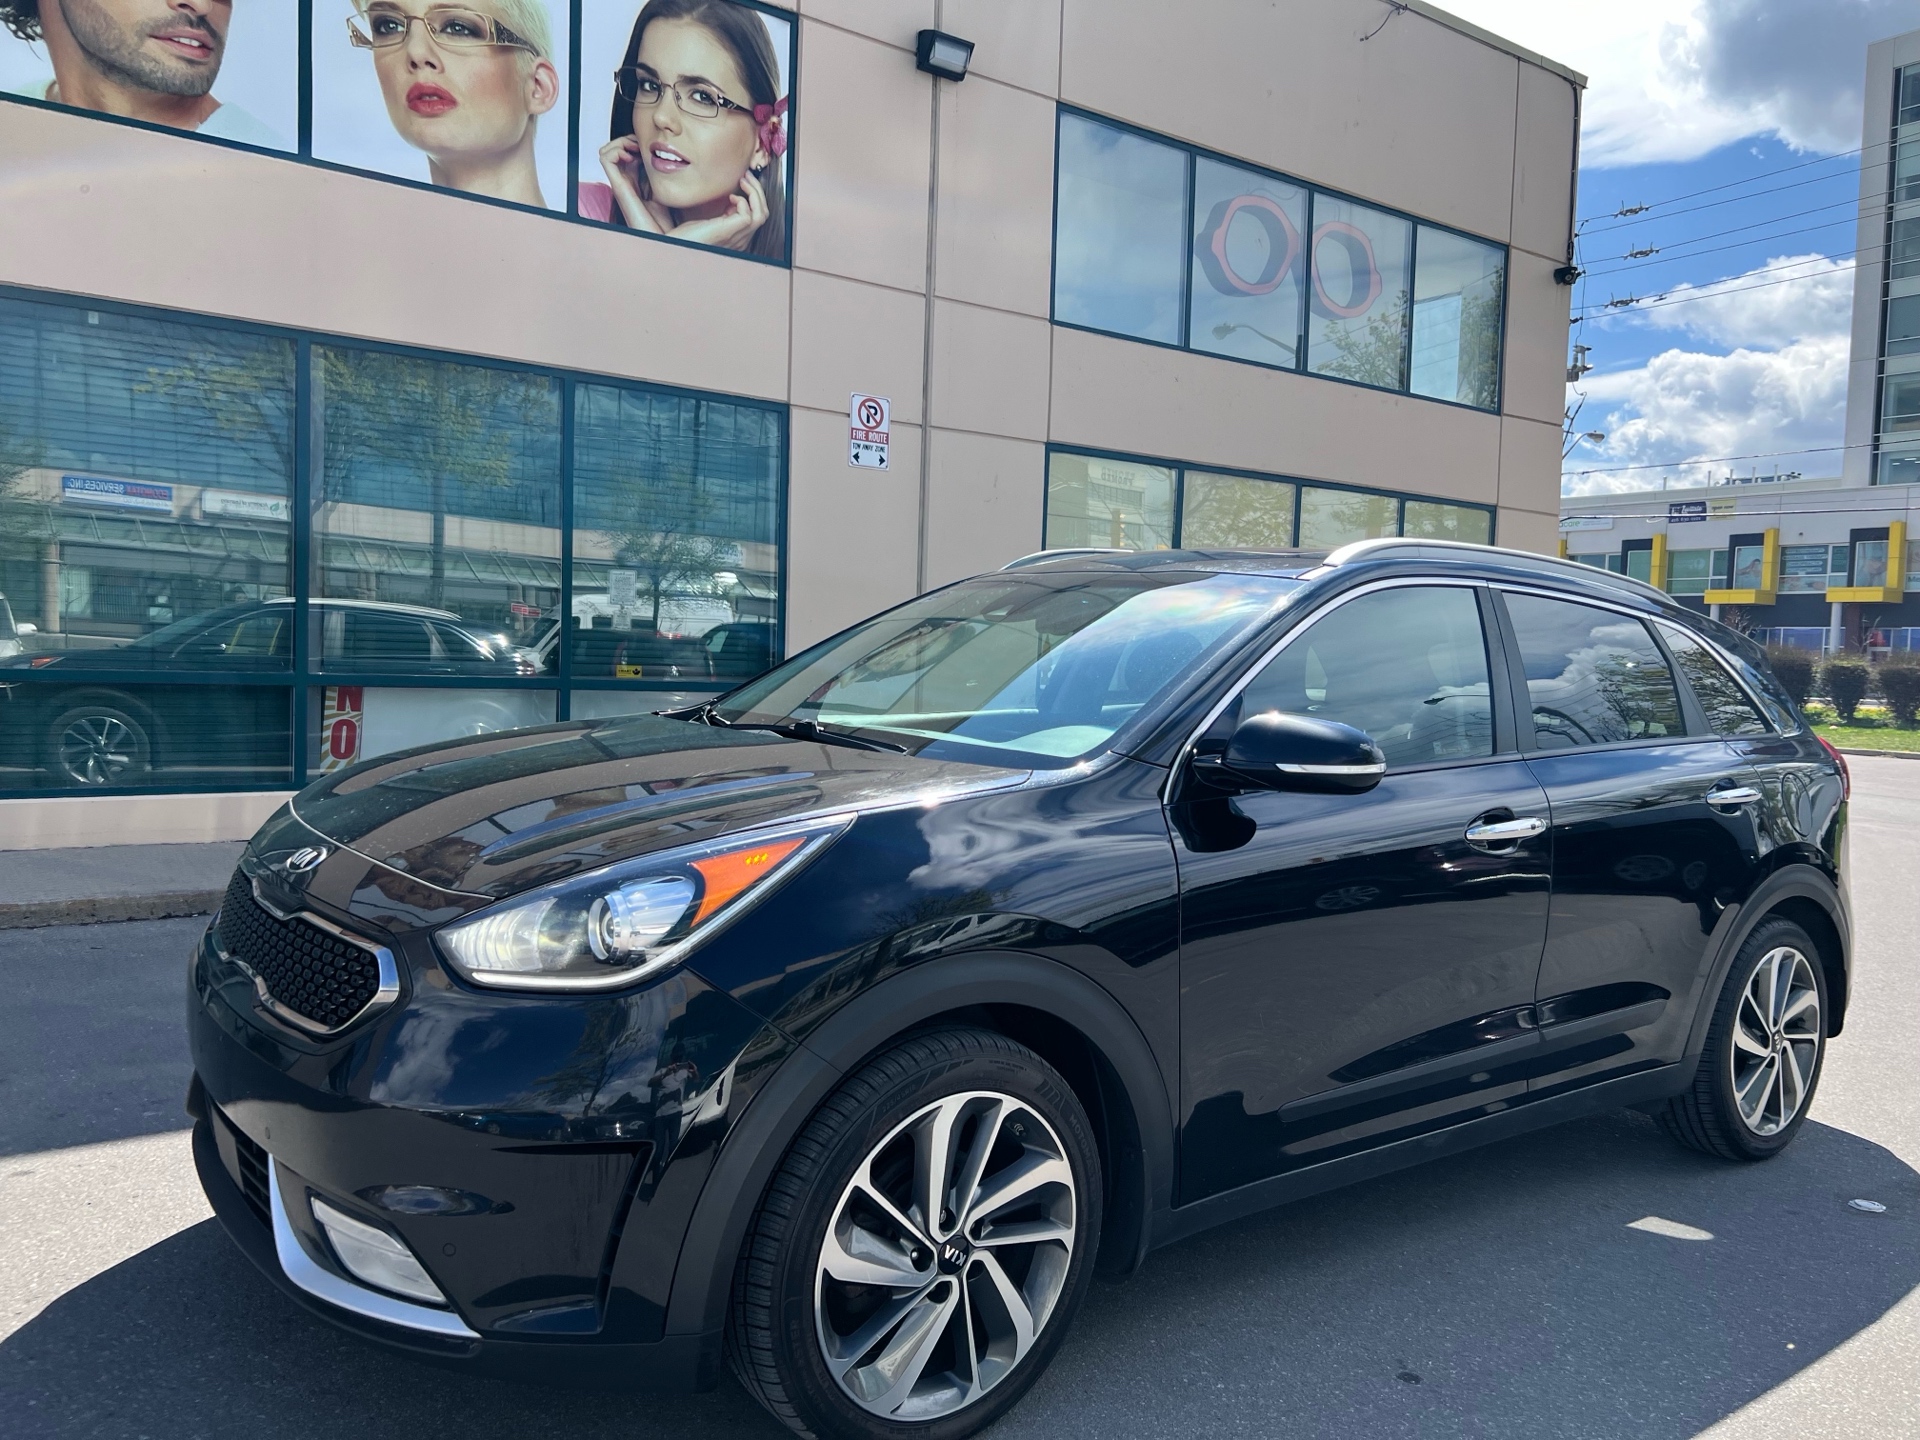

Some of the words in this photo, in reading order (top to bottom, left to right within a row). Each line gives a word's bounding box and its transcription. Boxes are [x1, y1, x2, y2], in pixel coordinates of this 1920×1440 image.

[852, 430, 866, 440] FIRE
[868, 432, 887, 443] ROUTE
[852, 442, 861, 450] TOW
[292, 847, 318, 868] KIA
[945, 1245, 967, 1267] KIA
